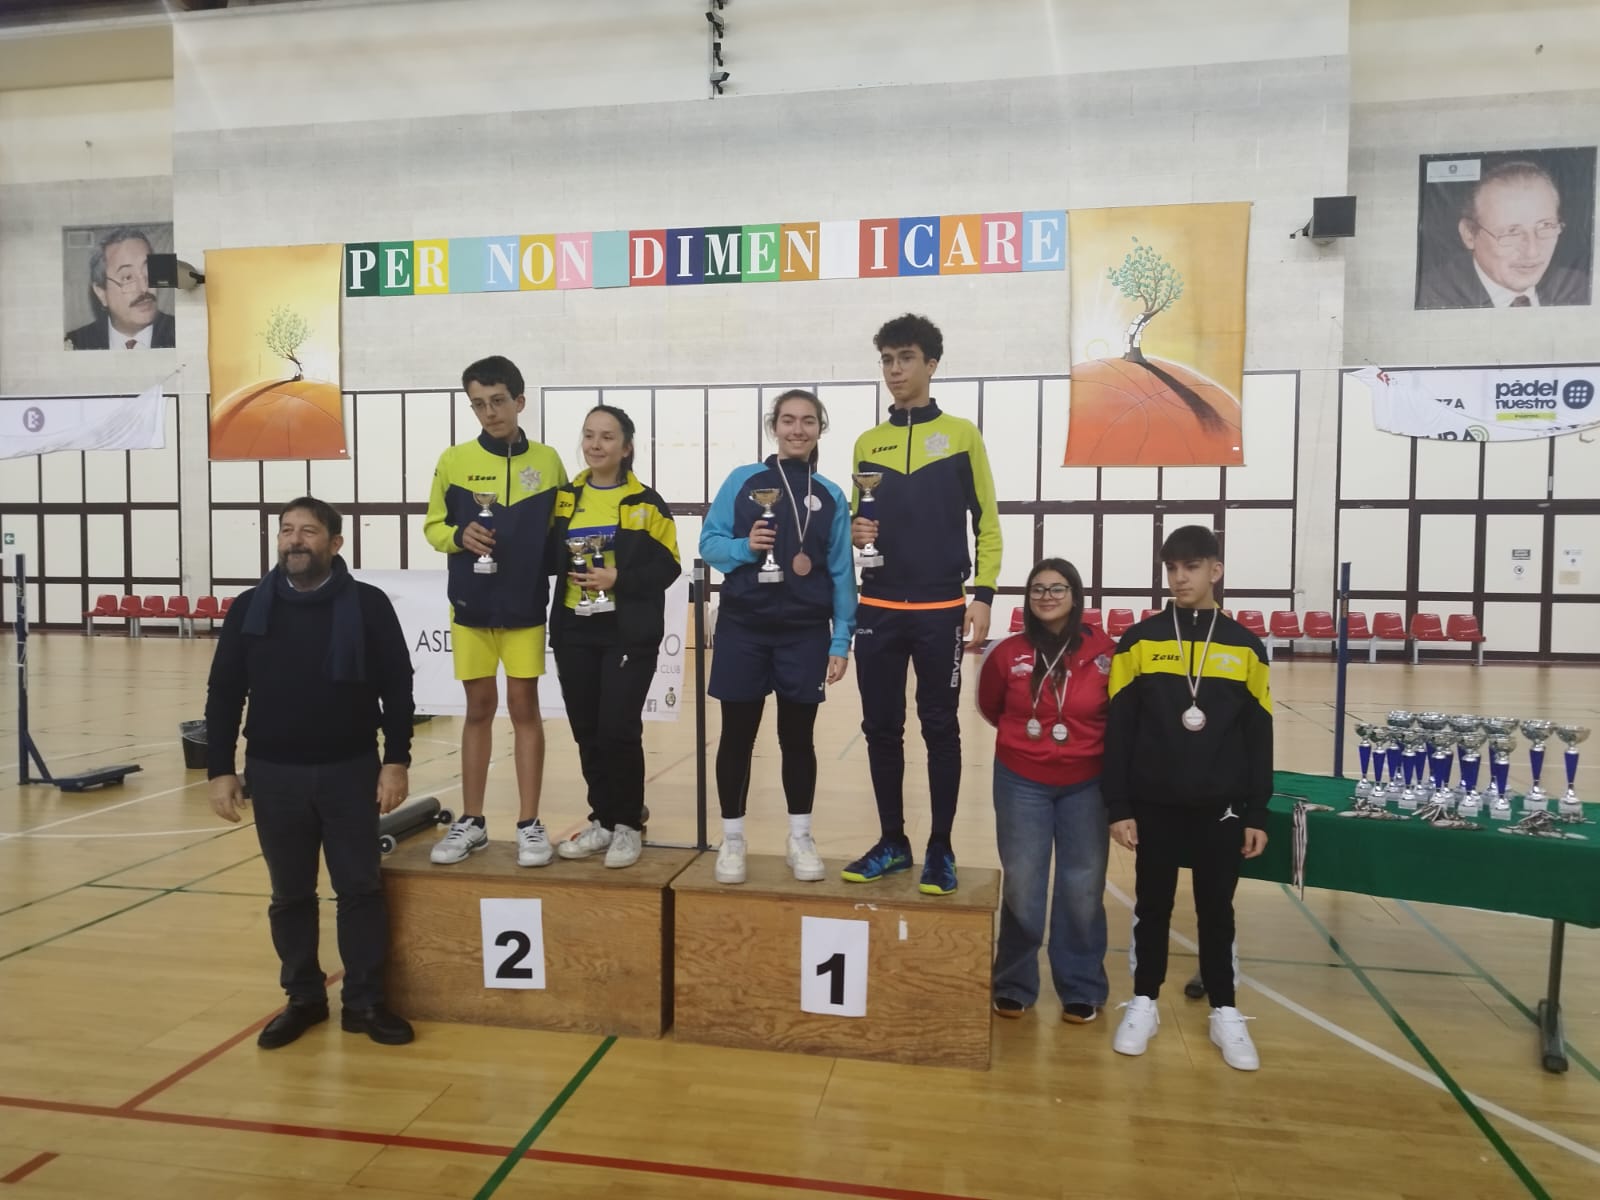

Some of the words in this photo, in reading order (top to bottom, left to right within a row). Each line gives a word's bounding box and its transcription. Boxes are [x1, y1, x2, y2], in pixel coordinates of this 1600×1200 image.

[349, 246, 446, 290] PER
[486, 239, 589, 285] NON
[631, 229, 818, 279] DIMEN
[869, 217, 1060, 270] ICARE
[1495, 398, 1557, 410] nuestro
[1152, 653, 1180, 661] Zeus
[494, 930, 533, 979] 2
[816, 953, 845, 1005] 1
